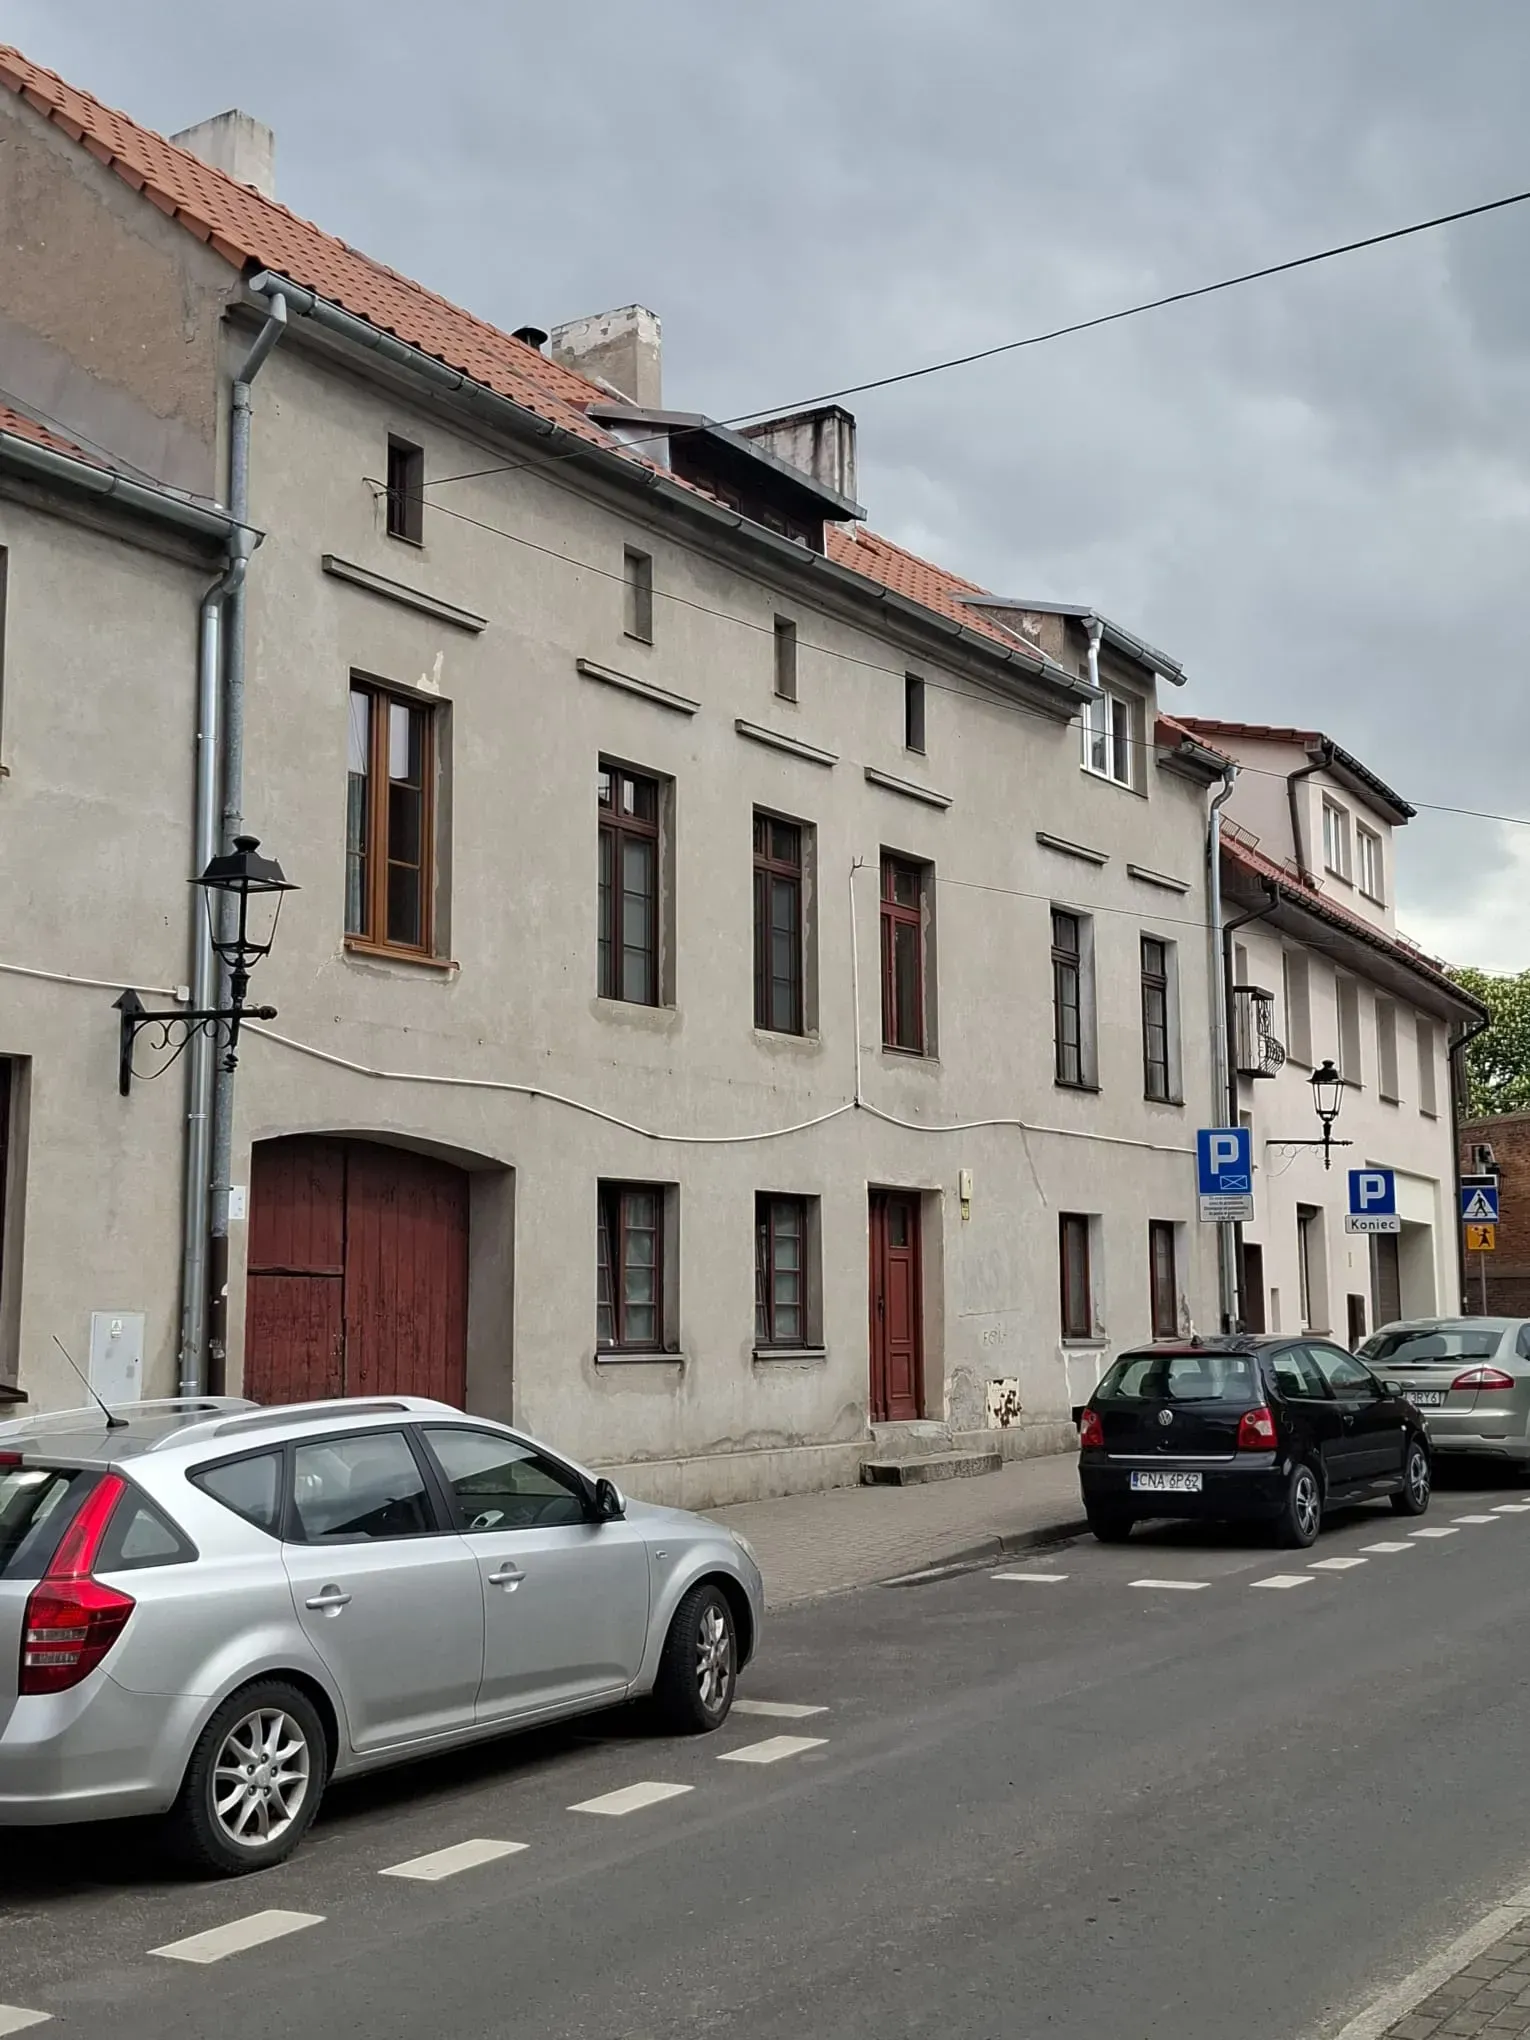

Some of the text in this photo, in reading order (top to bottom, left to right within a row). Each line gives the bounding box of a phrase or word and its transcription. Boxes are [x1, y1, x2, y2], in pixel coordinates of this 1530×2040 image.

[1209, 1134, 1239, 1175] P
[1359, 1174, 1386, 1209] P
[1351, 1218, 1395, 1230] Koniec
[1139, 1472, 1165, 1488] CNA
